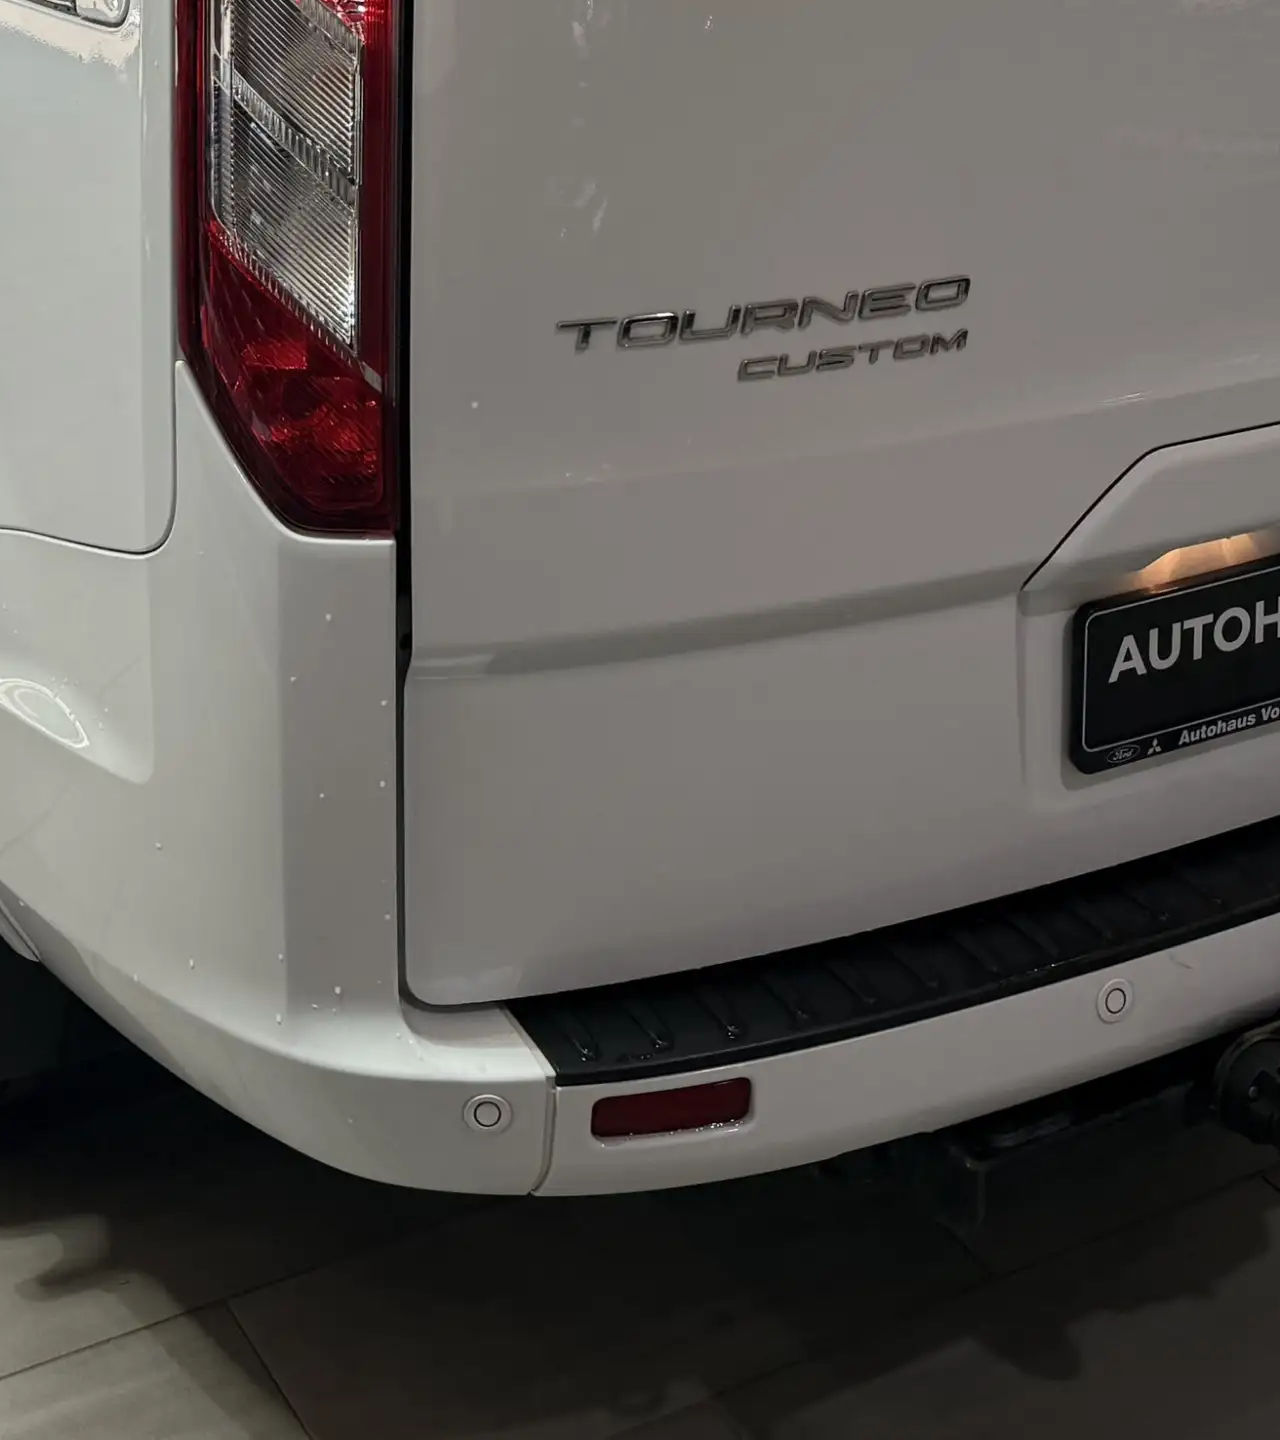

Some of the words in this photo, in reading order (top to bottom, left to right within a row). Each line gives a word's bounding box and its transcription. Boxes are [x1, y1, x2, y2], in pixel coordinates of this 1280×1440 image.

[556, 275, 972, 355] TOURNEO
[736, 328, 969, 383] CUSTOM
[1179, 712, 1256, 746] Autohaus
